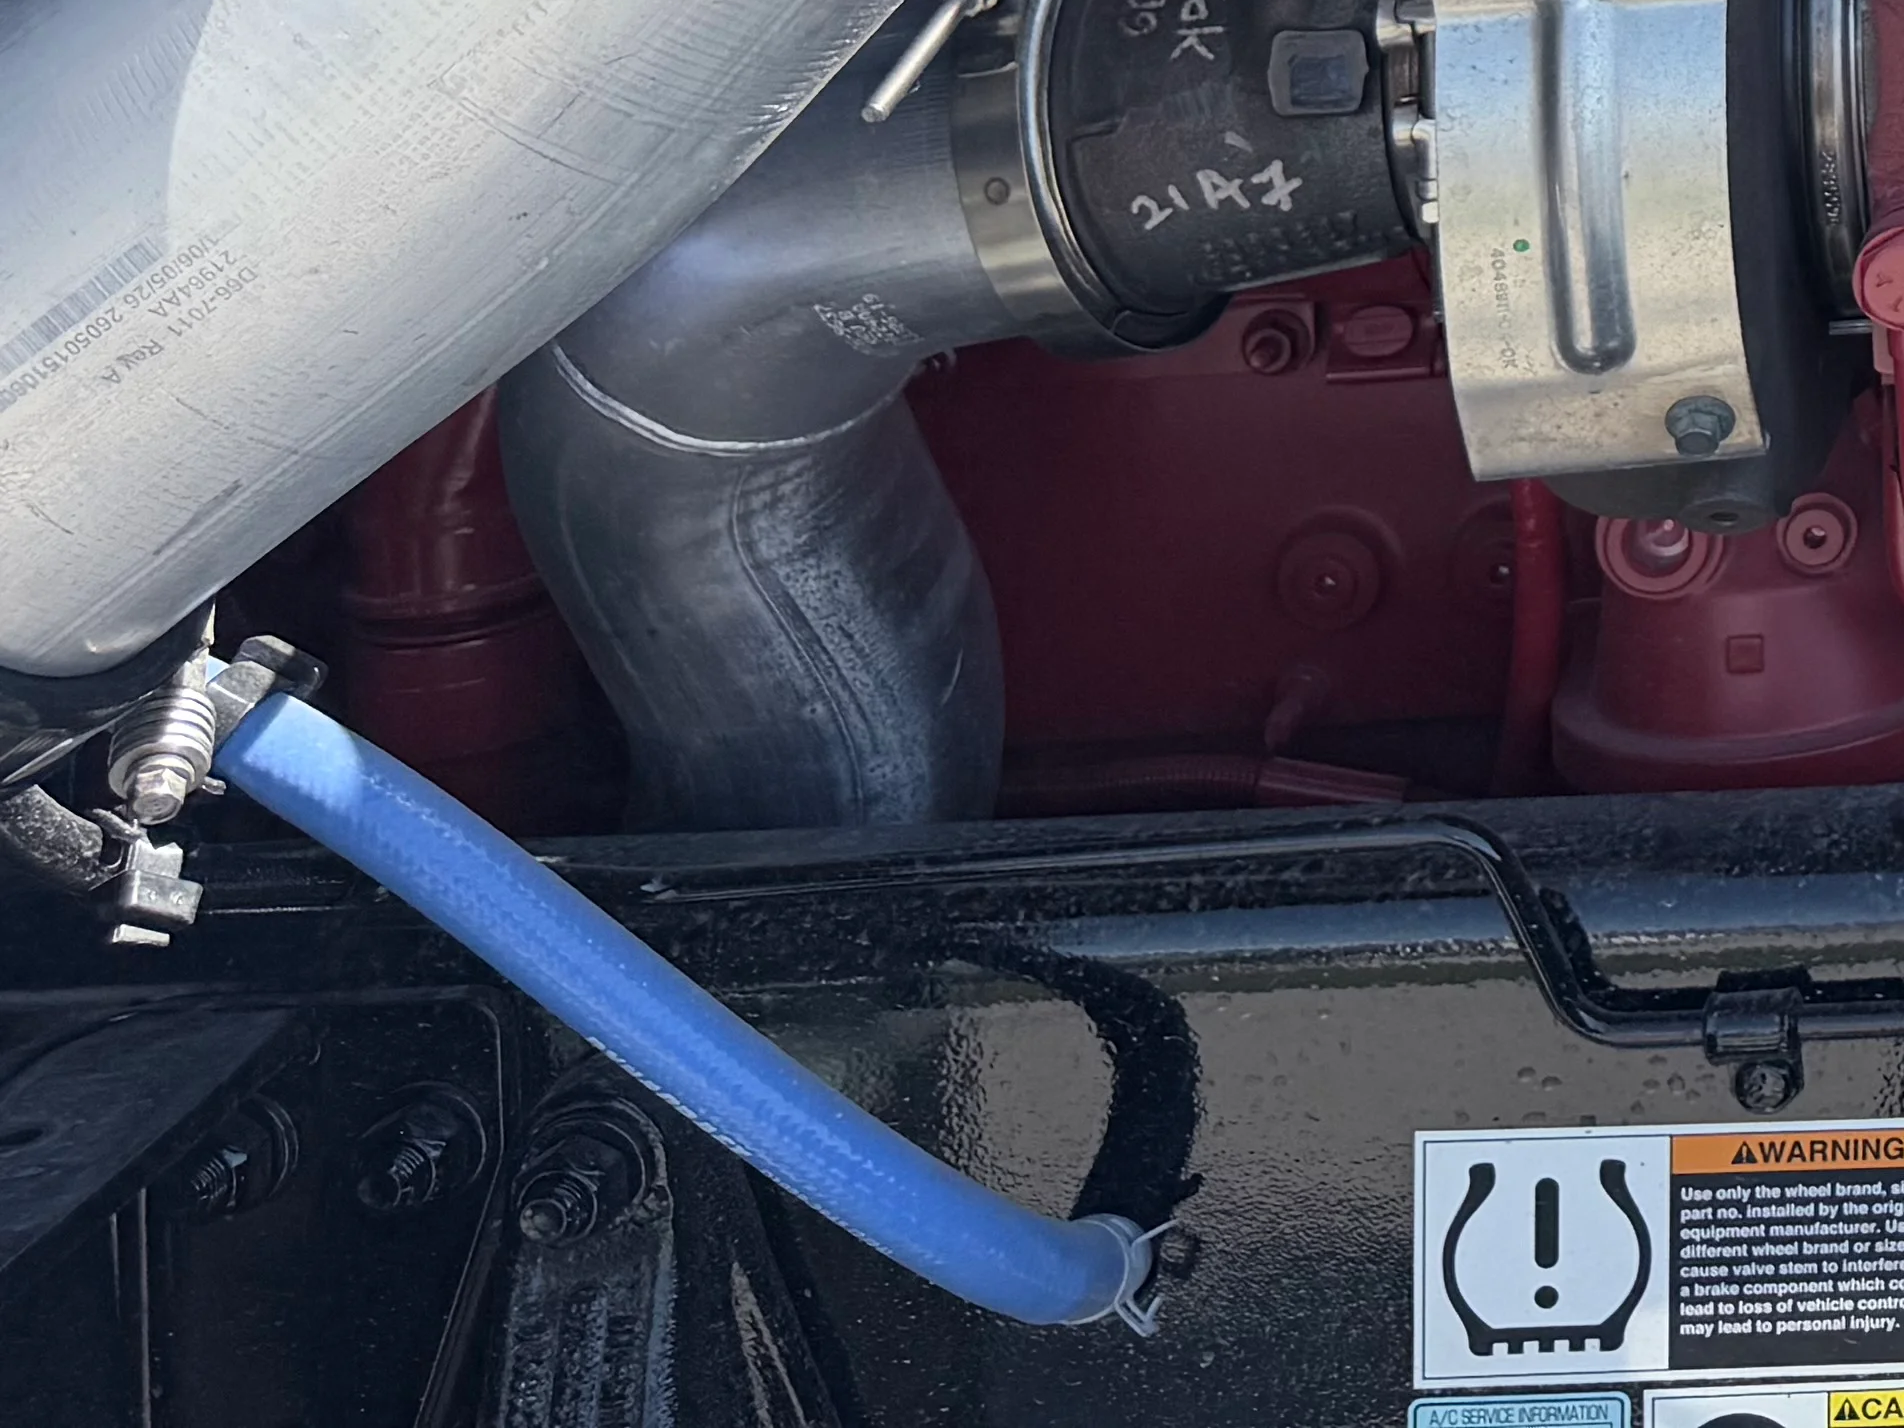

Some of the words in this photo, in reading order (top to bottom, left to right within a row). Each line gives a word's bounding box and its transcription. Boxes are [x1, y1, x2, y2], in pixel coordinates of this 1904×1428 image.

[147, 248, 235, 322] 21964AA
[166, 264, 258, 340] D66-7011
[116, 335, 163, 373] Rev
[1759, 1137, 1904, 1163] WARNING
[1682, 1186, 1712, 1205] Use
[1716, 1185, 1750, 1204] only
[1756, 1184, 1780, 1202] the
[1785, 1182, 1831, 1201] wheel
[1836, 1180, 1886, 1200] brand,
[1681, 1207, 1712, 1224] part
[1717, 1206, 1742, 1223] no.
[1747, 1203, 1814, 1222] installed
[1819, 1203, 1838, 1220] by
[1843, 1202, 1868, 1219] the
[1680, 1224, 1766, 1243] equipment
[1769, 1221, 1881, 1241] manufacturer.
[1680, 1243, 1748, 1260] different
[1752, 1242, 1798, 1258] wheel
[1802, 1240, 1849, 1256] brand
[1853, 1239, 1871, 1254] or
[1680, 1264, 1728, 1282] cause
[1732, 1262, 1775, 1281] valve
[1779, 1261, 1818, 1279] stem
[1822, 1260, 1838, 1278] to
[1680, 1284, 1690, 1301] a
[1694, 1282, 1740, 1301] brake
[1743, 1279, 1834, 1299] component
[1837, 1278, 1885, 1296] which
[1680, 1301, 1714, 1317] lead
[1718, 1300, 1735, 1316] to
[1738, 1299, 1772, 1315] loss
[1776, 1298, 1794, 1314] of
[1796, 1297, 1854, 1313] vehicle
[1680, 1321, 1714, 1338] may
[1718, 1320, 1752, 1336] lead
[1756, 1319, 1772, 1335] to
[1776, 1317, 1846, 1335] personal
[1850, 1315, 1900, 1333] injury.
[1429, 1410, 1458, 1426] A/C
[1462, 1408, 1514, 1424] SERVICE
[1518, 1405, 1608, 1423] INFORMATION
